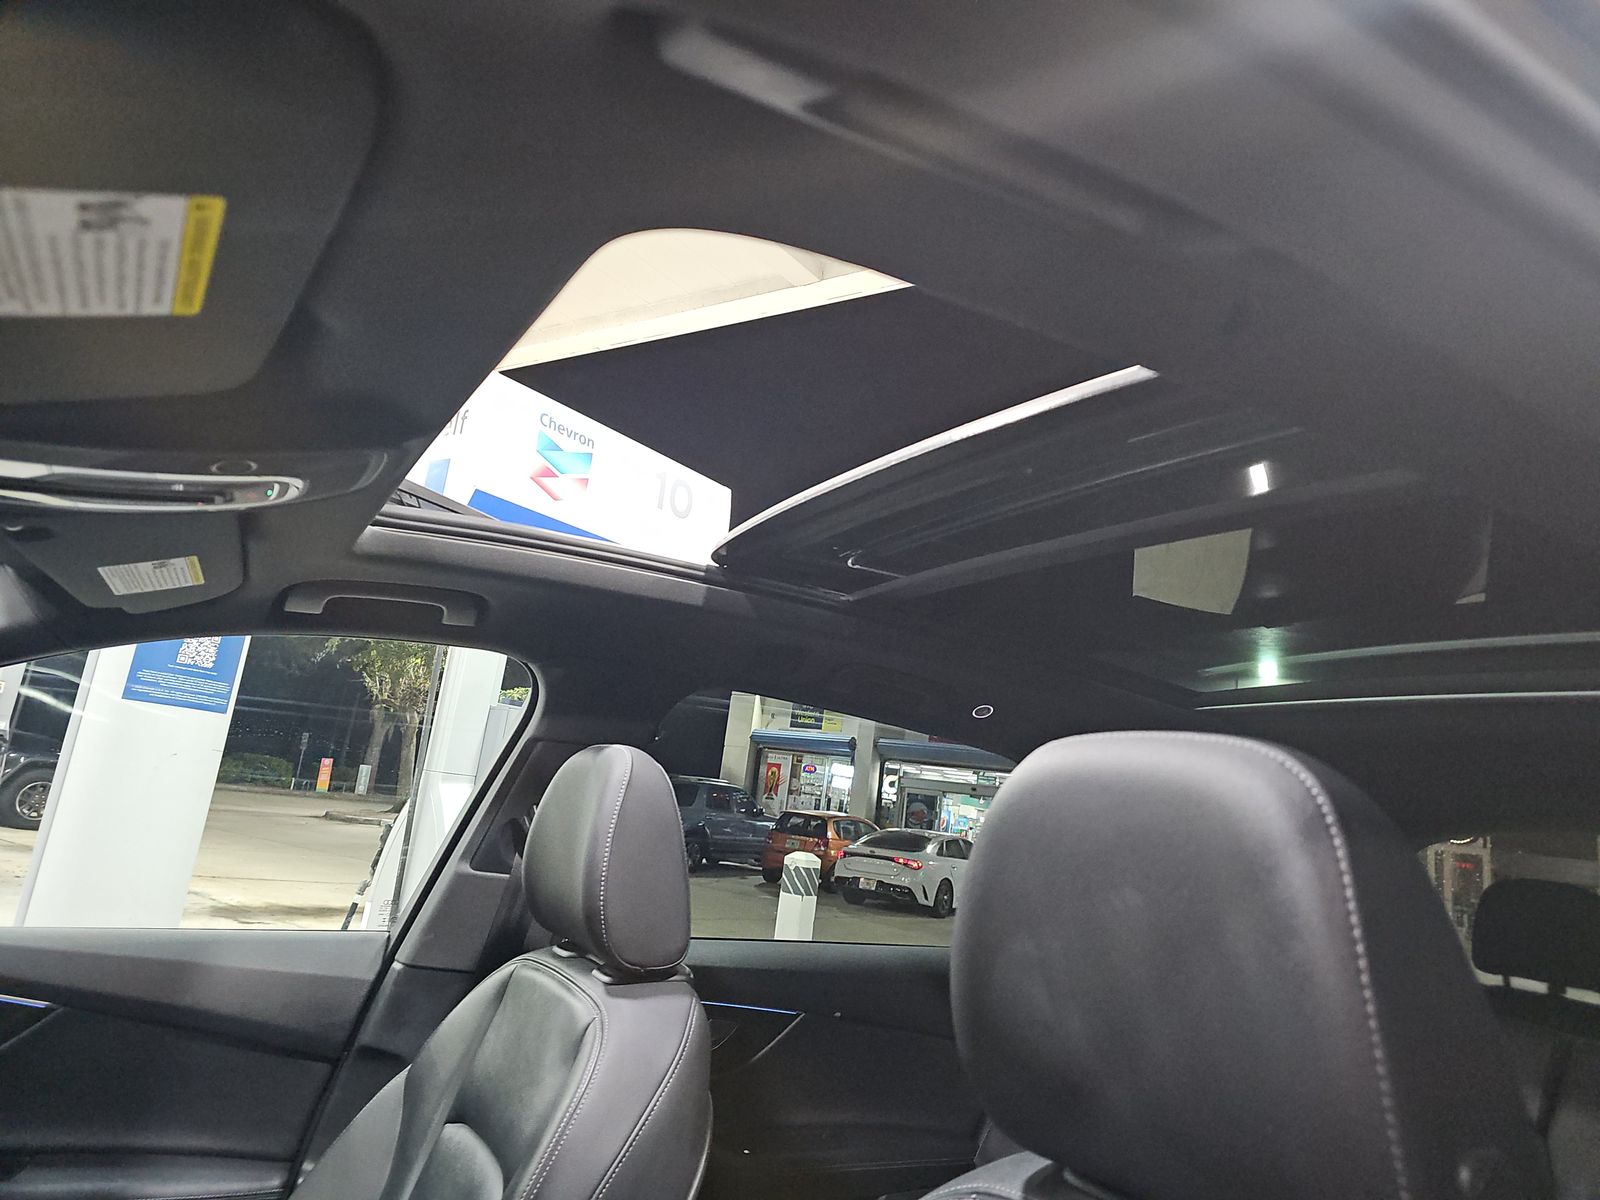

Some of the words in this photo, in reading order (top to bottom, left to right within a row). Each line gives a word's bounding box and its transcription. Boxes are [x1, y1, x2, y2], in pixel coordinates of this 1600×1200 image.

[539, 412, 595, 449] Chevron
[656, 471, 693, 519] 10
[797, 716, 816, 724] Union
